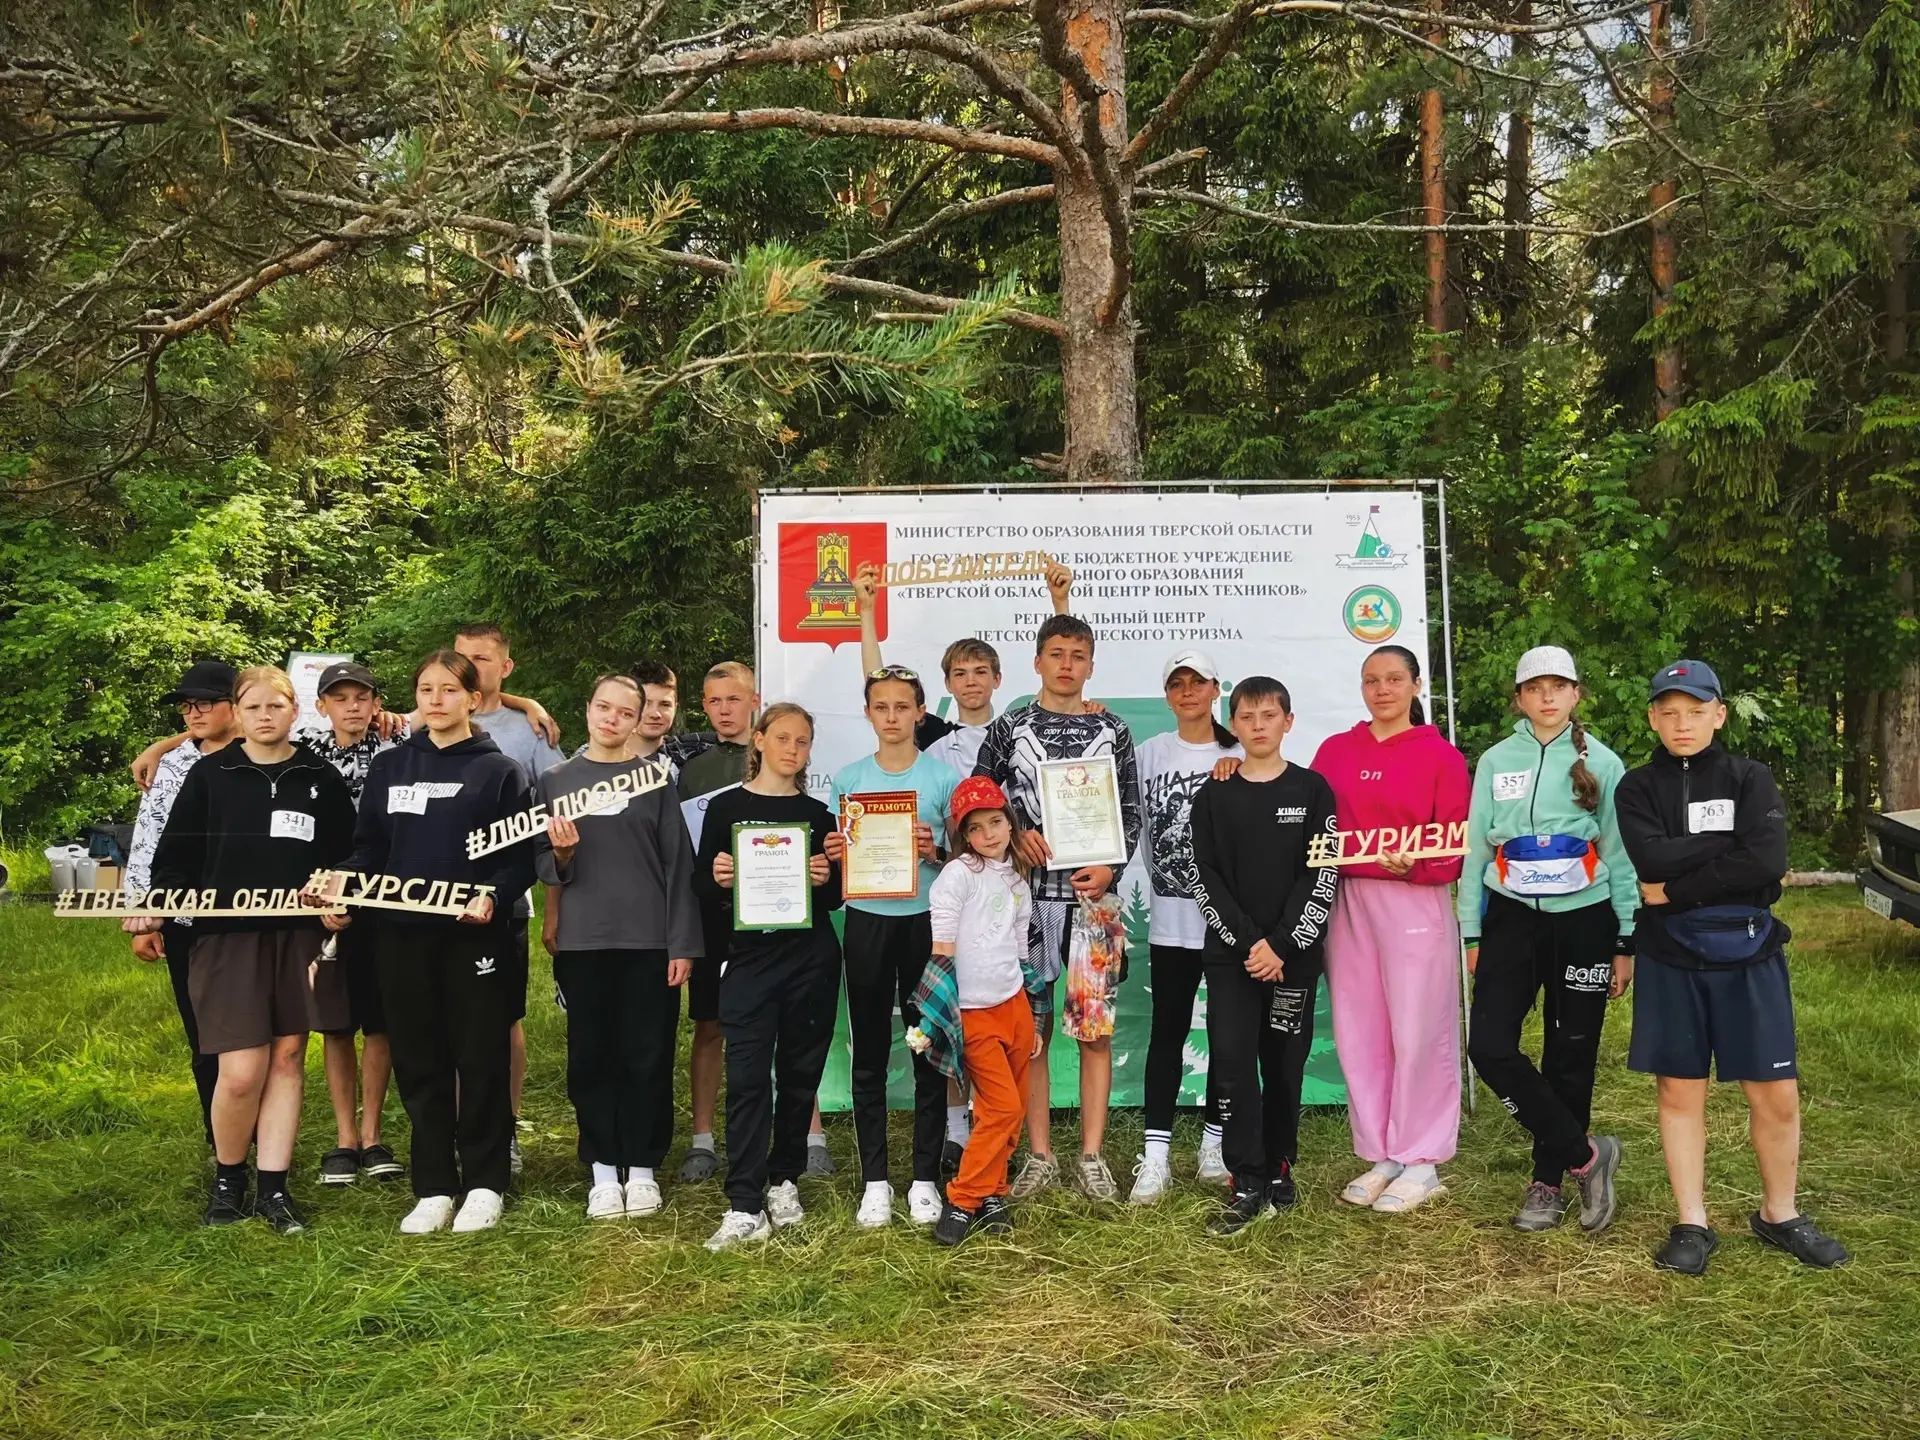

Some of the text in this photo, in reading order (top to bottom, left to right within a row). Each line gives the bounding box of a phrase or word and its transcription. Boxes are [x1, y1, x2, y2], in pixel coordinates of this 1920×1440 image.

[894, 521, 1313, 539] МИНИСТЕРСТВО ОБРАЗОВАНИЯ ТВЕРСКОЙ ОБЛАСТИ
[1074, 551, 1179, 567] БЮДЖЕТНОЕ
[1183, 550, 1294, 565] УЧРЕЖДЕНИЕ
[1130, 567, 1244, 581] ОБРАЗОВАНИЯ
[897, 583, 1308, 599] «ТВЕРСКОЙ ОБЛАСОЙ ЦЕНТР ЮНЫХ ТЕХНИКОВ»
[1152, 611, 1206, 626] ЦЕНТР
[1168, 627, 1244, 641] ТУРИЗМА
[1501, 774, 1525, 788] 357
[394, 789, 416, 801] 321
[1056, 786, 1101, 799] ГРАМОТА
[867, 802, 912, 812] ГРАМОТА
[1700, 803, 1725, 819] 263
[282, 812, 306, 827] 341
[1307, 820, 1469, 863] #ТУРИЗМ
[308, 868, 496, 914] #ТУРСЛЕТ
[55, 888, 347, 911] #ТВЕРСКАЯ ОБЛА
[1565, 965, 1610, 984] BORN
